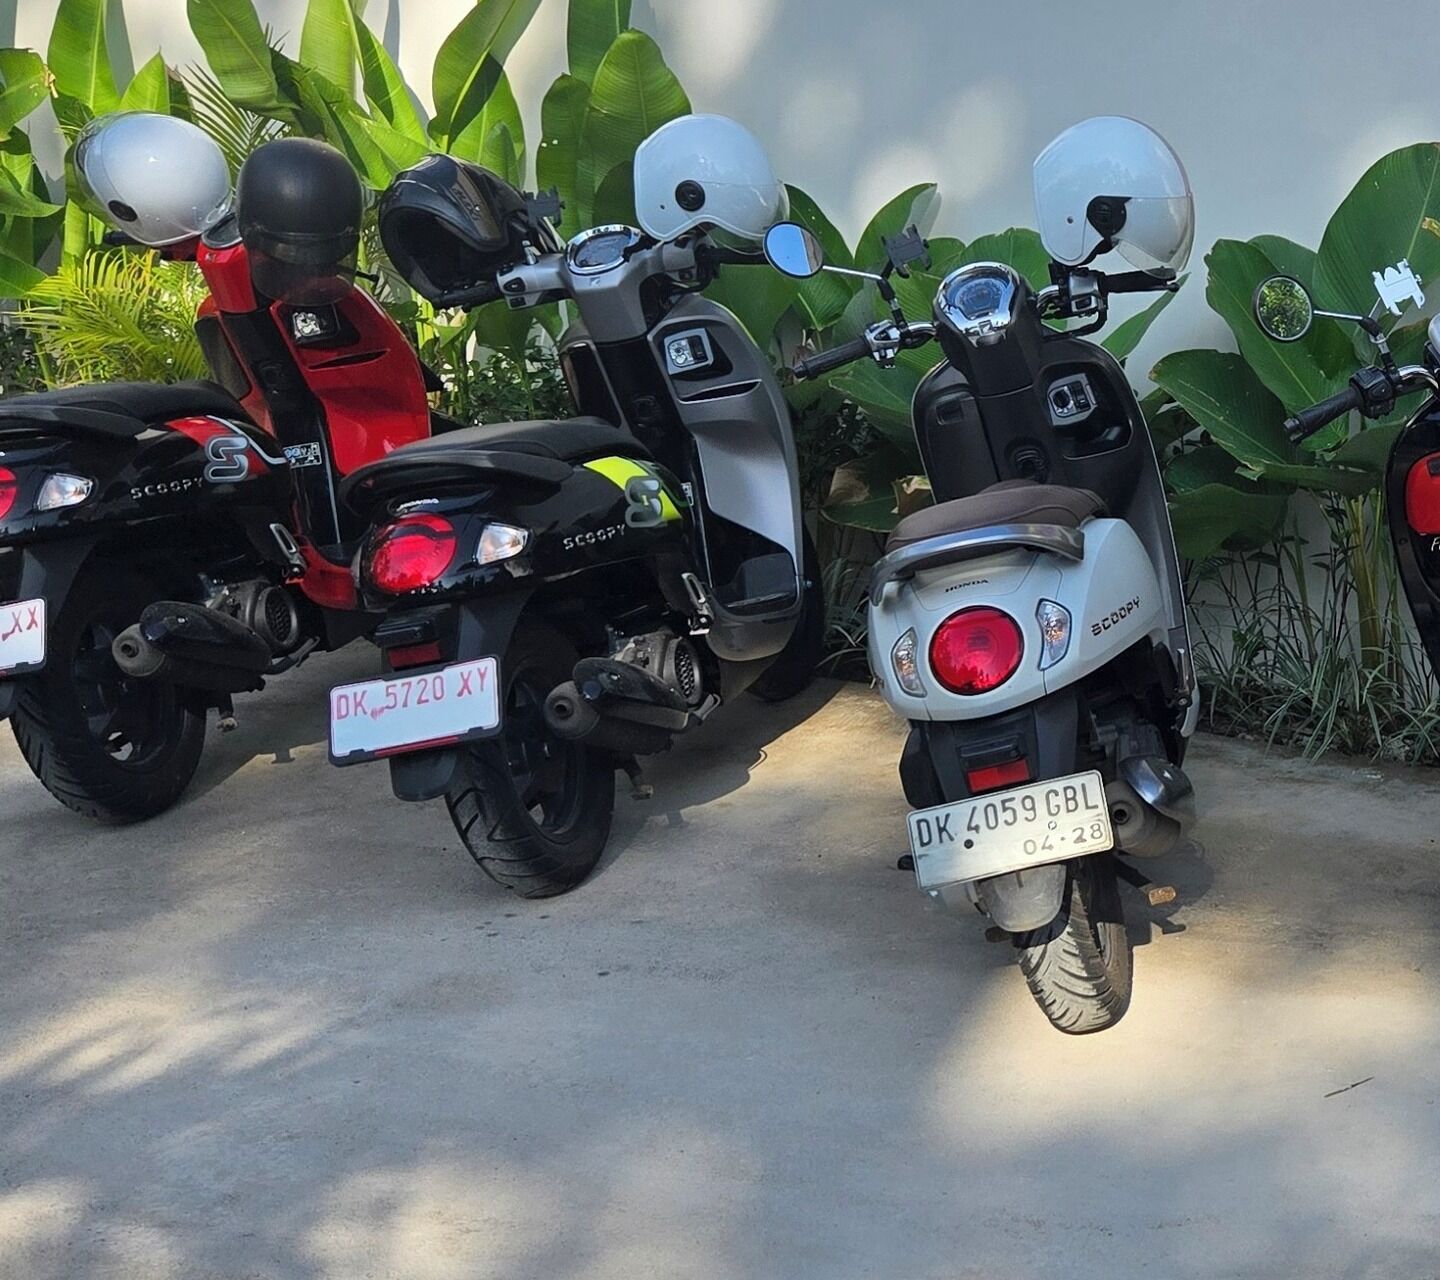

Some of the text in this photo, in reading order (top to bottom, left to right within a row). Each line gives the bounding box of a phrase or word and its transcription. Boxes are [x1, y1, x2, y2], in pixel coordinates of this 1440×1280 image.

[130, 476, 204, 500] SCOOPY
[562, 524, 627, 550] SCOOPY
[945, 579, 989, 593] HONDA
[1091, 596, 1141, 636] SCOOPY
[336, 667, 488, 720] DK 5720 XY
[916, 783, 1099, 848] DK 4059 GBL
